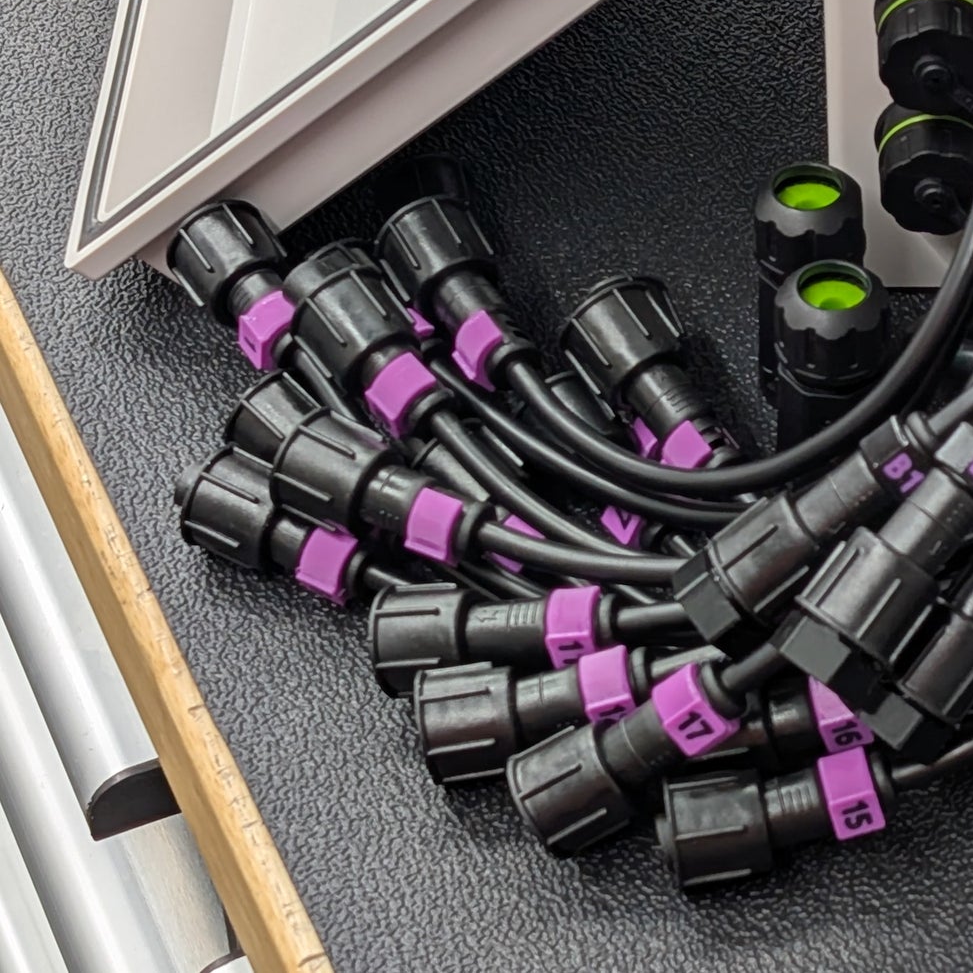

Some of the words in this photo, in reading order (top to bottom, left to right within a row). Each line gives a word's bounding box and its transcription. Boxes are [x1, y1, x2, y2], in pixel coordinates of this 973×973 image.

[882, 452, 925, 494] B1
[677, 711, 716, 741] 17
[831, 720, 864, 747] 16
[841, 799, 874, 831] 15
